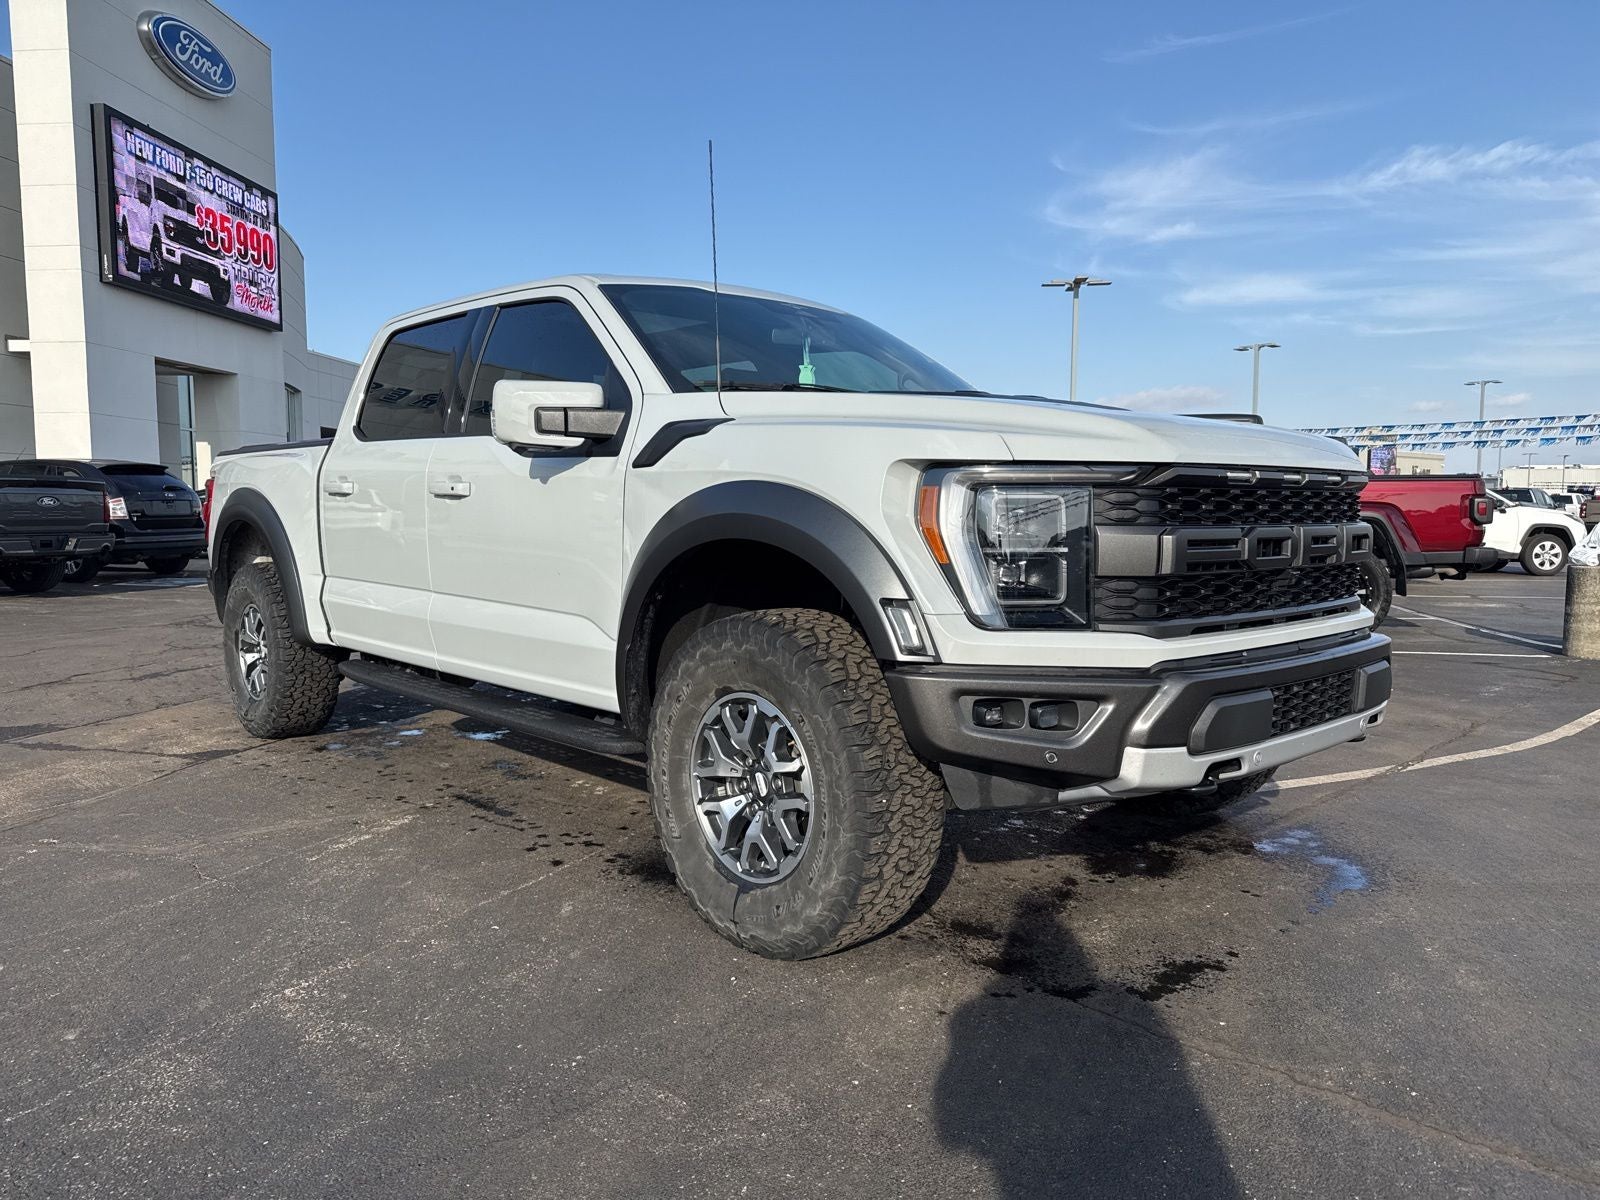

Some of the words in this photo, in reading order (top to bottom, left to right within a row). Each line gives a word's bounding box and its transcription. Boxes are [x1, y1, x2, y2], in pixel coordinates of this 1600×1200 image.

[175, 29, 224, 85] Ford
[126, 131, 154, 162] NEW
[155, 145, 184, 177] FORD
[186, 162, 214, 191] F-150
[215, 174, 243, 206] CREW
[244, 189, 268, 217] CABS
[232, 263, 276, 300] TRUCK
[235, 282, 273, 313] Month
[1160, 522, 1373, 577] FORD
